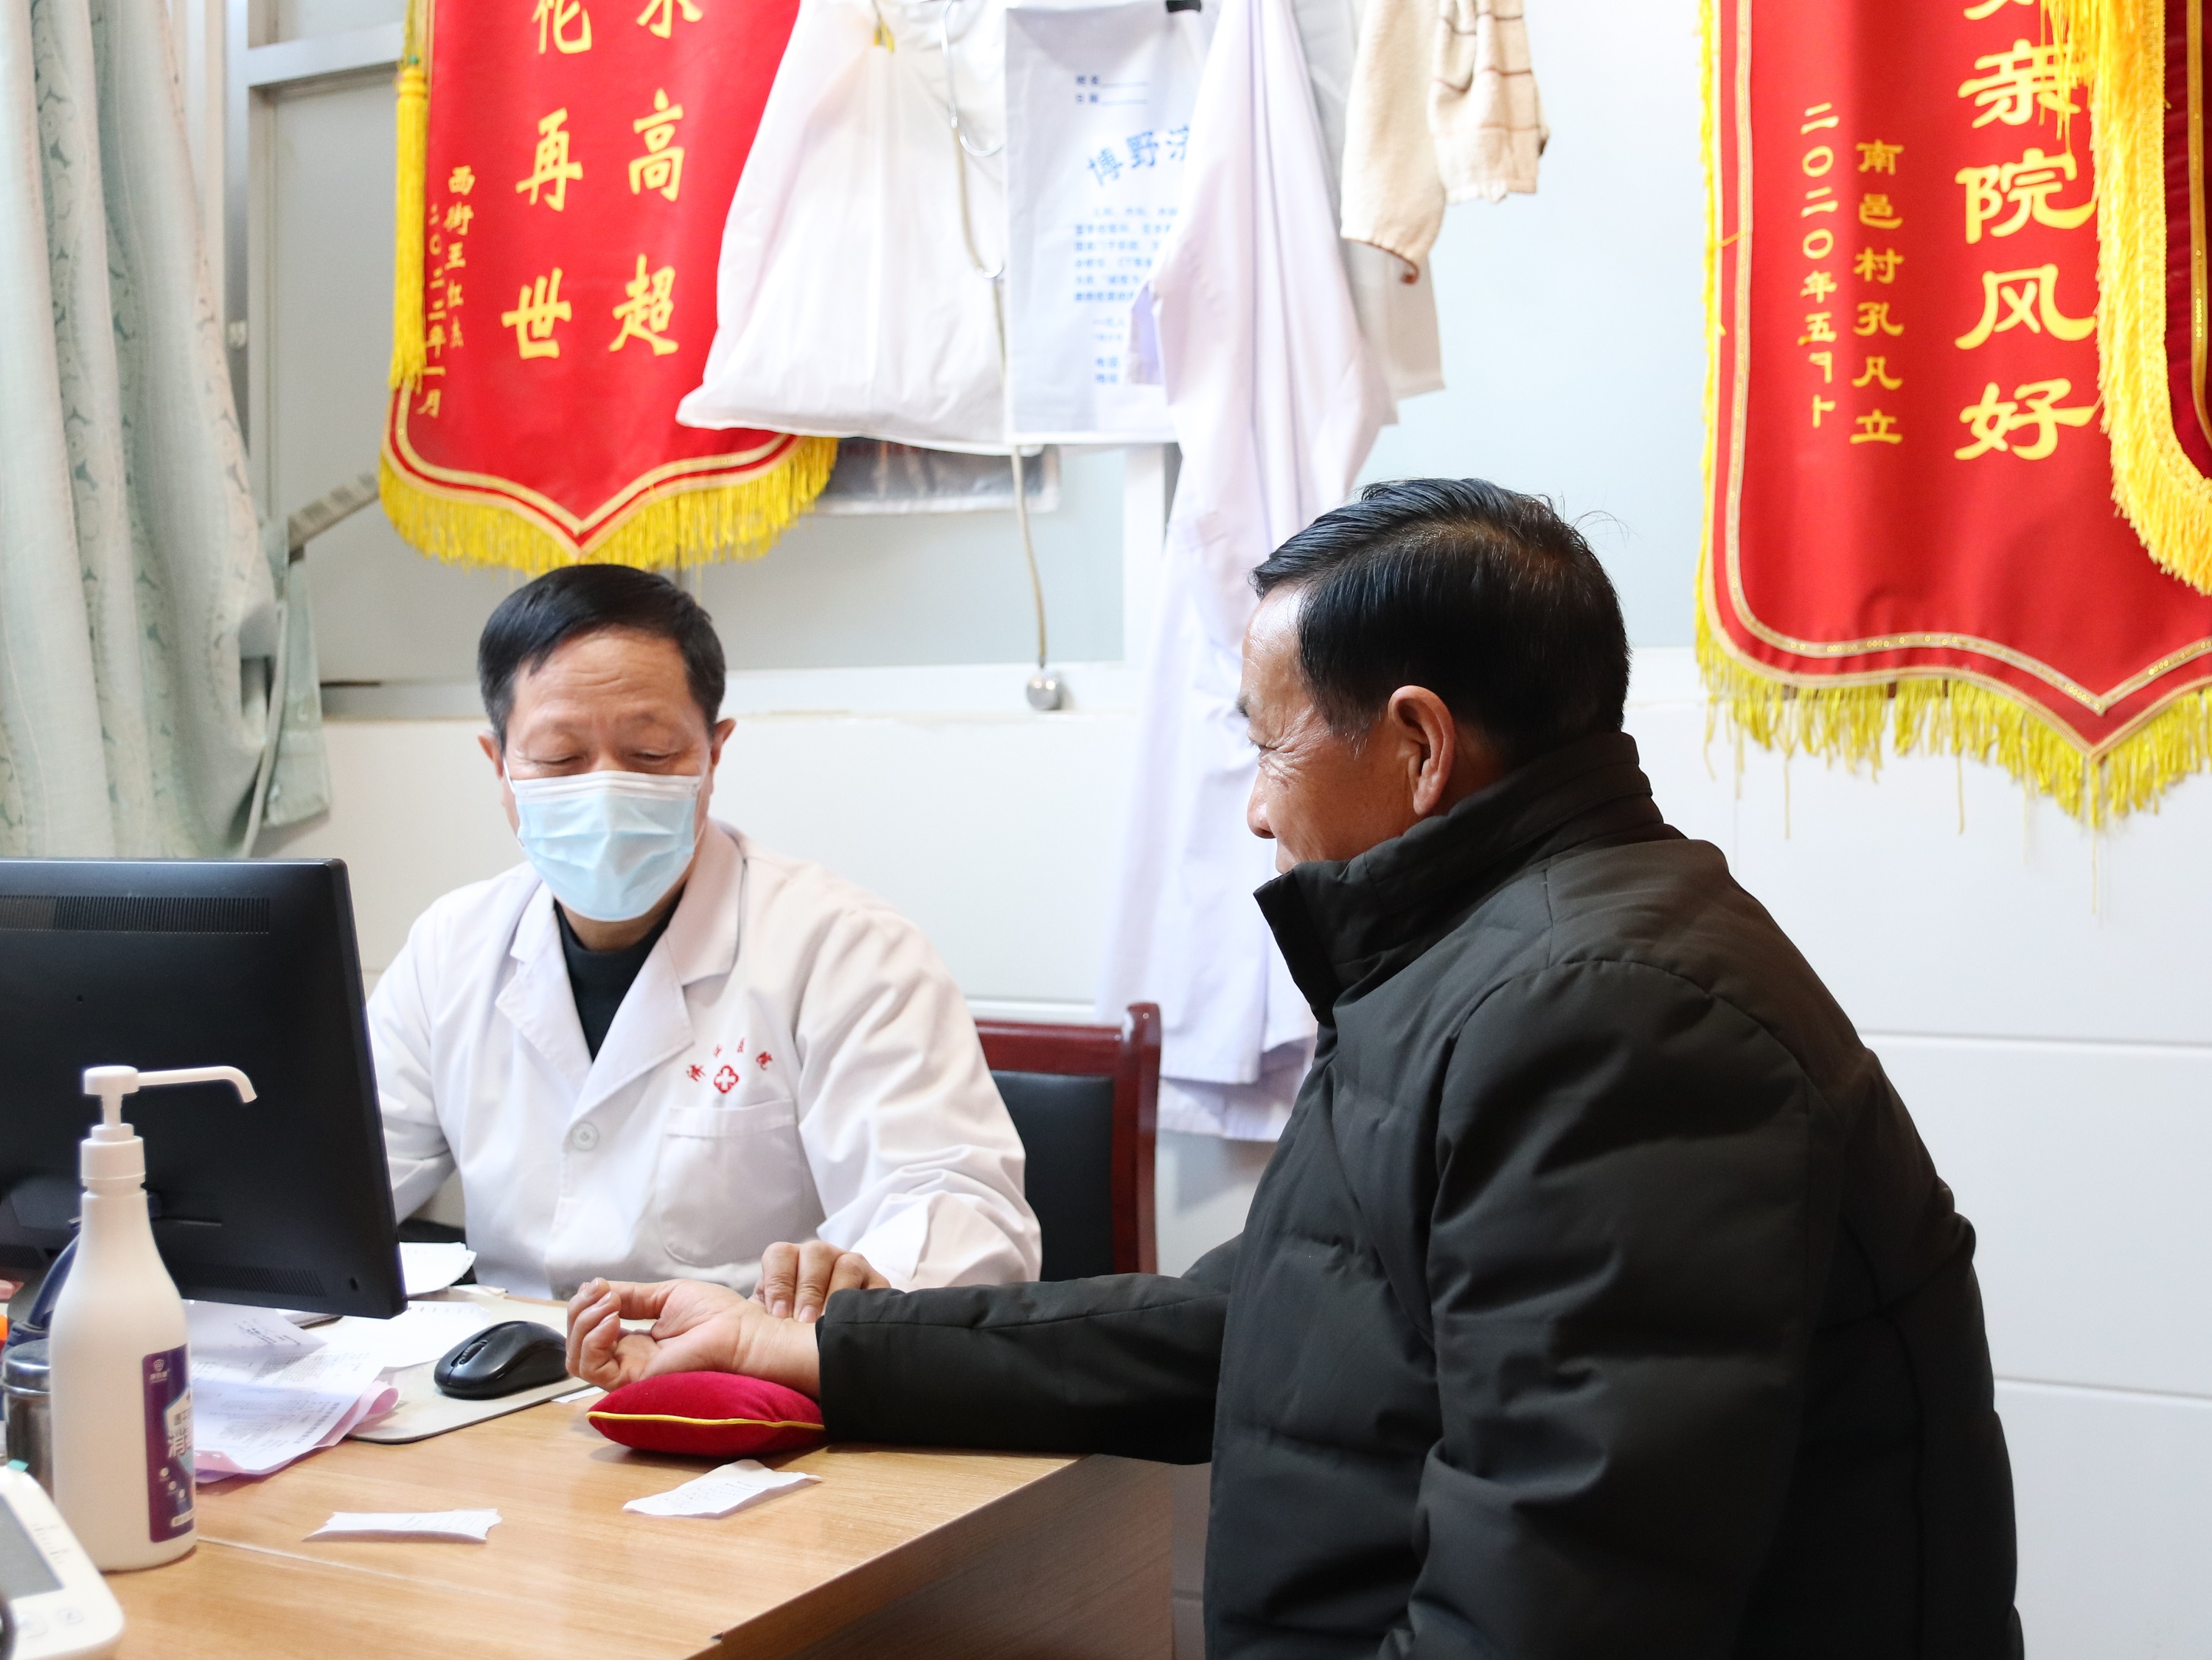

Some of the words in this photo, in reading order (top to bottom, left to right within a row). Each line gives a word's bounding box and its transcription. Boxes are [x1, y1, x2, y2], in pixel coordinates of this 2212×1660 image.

[1849, 139, 1904, 444] 南邑村孔凡立
[1955, 0, 2098, 461] 亲院风好
